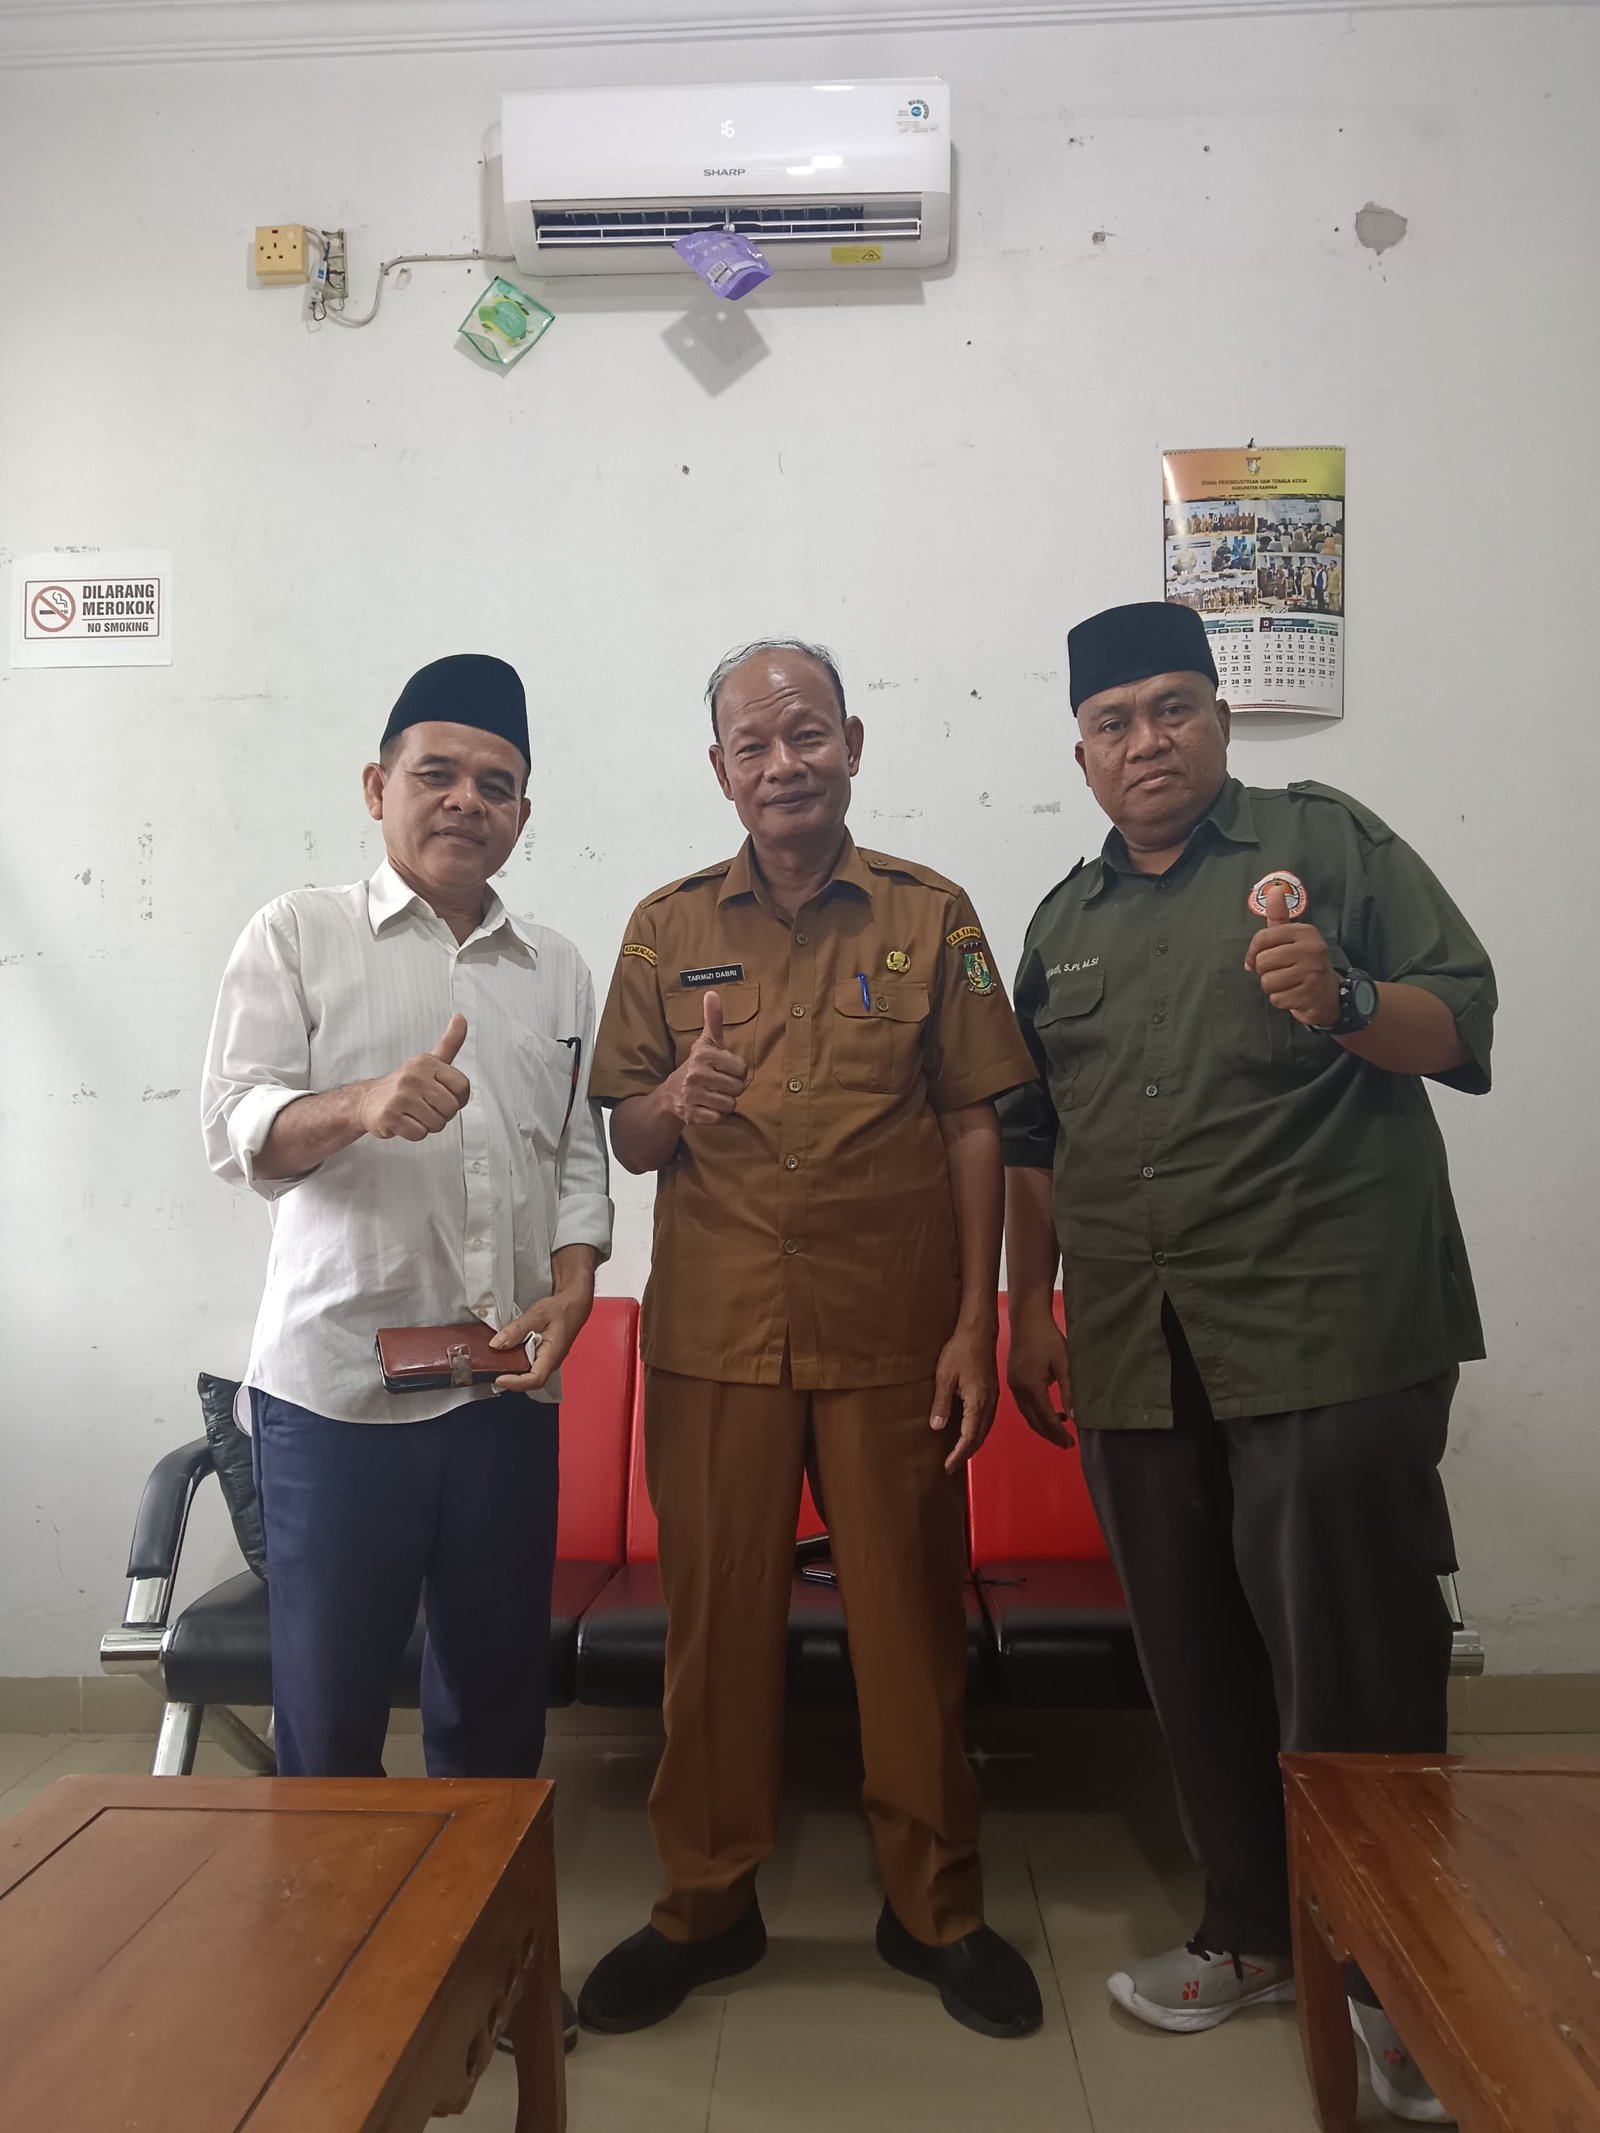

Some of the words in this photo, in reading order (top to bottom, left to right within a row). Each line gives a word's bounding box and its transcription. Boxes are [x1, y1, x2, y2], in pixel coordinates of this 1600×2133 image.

[721, 120, 735, 138] 16
[703, 168, 746, 177] SHARP
[83, 584, 154, 599] DILARANG
[82, 600, 155, 616] MEROKOK
[88, 623, 101, 633] NO
[104, 622, 149, 632] SMOKING
[687, 973, 714, 982] TARMIZI
[715, 970, 737, 978] DABRI
